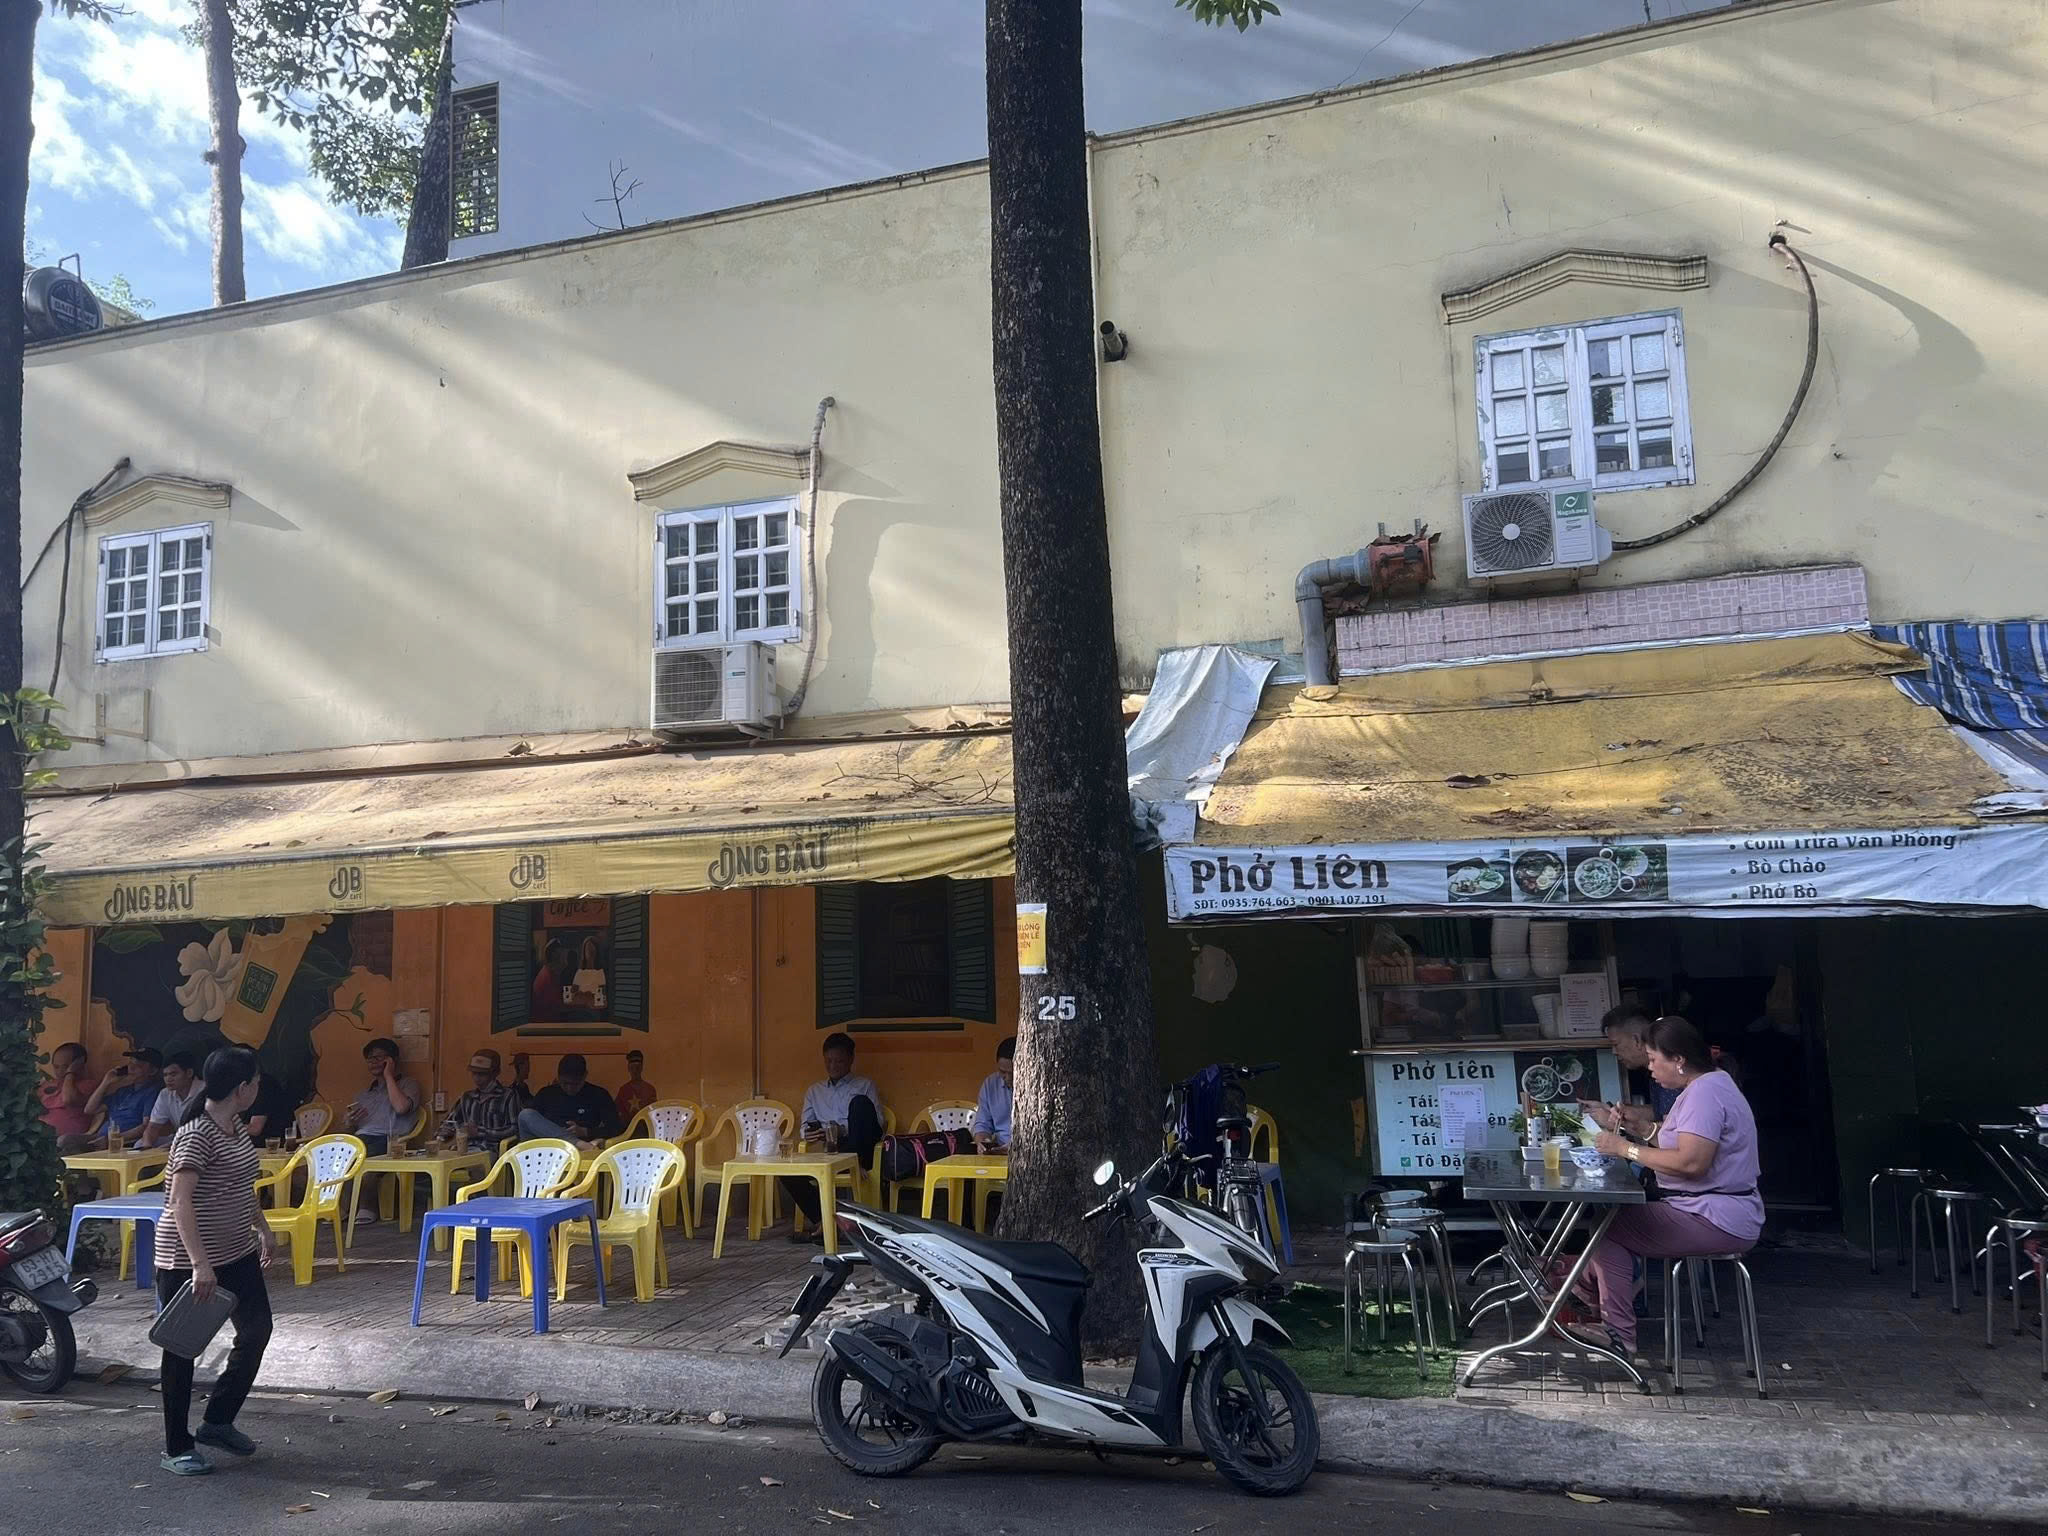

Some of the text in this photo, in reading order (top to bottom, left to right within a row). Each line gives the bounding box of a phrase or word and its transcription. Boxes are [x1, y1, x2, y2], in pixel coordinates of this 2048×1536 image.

[1891, 833, 1957, 850] Phòng
[708, 831, 832, 887] ÔNG BẦU
[1748, 857, 1826, 874] Bò Chảo
[1190, 853, 1389, 894] Phở Liên
[104, 874, 197, 921] ÔNG BẦU
[1750, 882, 1818, 899] Phở Bò
[1221, 896, 1296, 908] 0935.764.663
[1308, 894, 1386, 906] 0901.107.191
[1038, 995, 1076, 1020] 25
[1392, 1060, 1495, 1081] Phở Liên
[1412, 1133, 1436, 1146] Tái
[1416, 1153, 1465, 1170] Tô Đặ
[874, 1237, 958, 1291] VARIO
